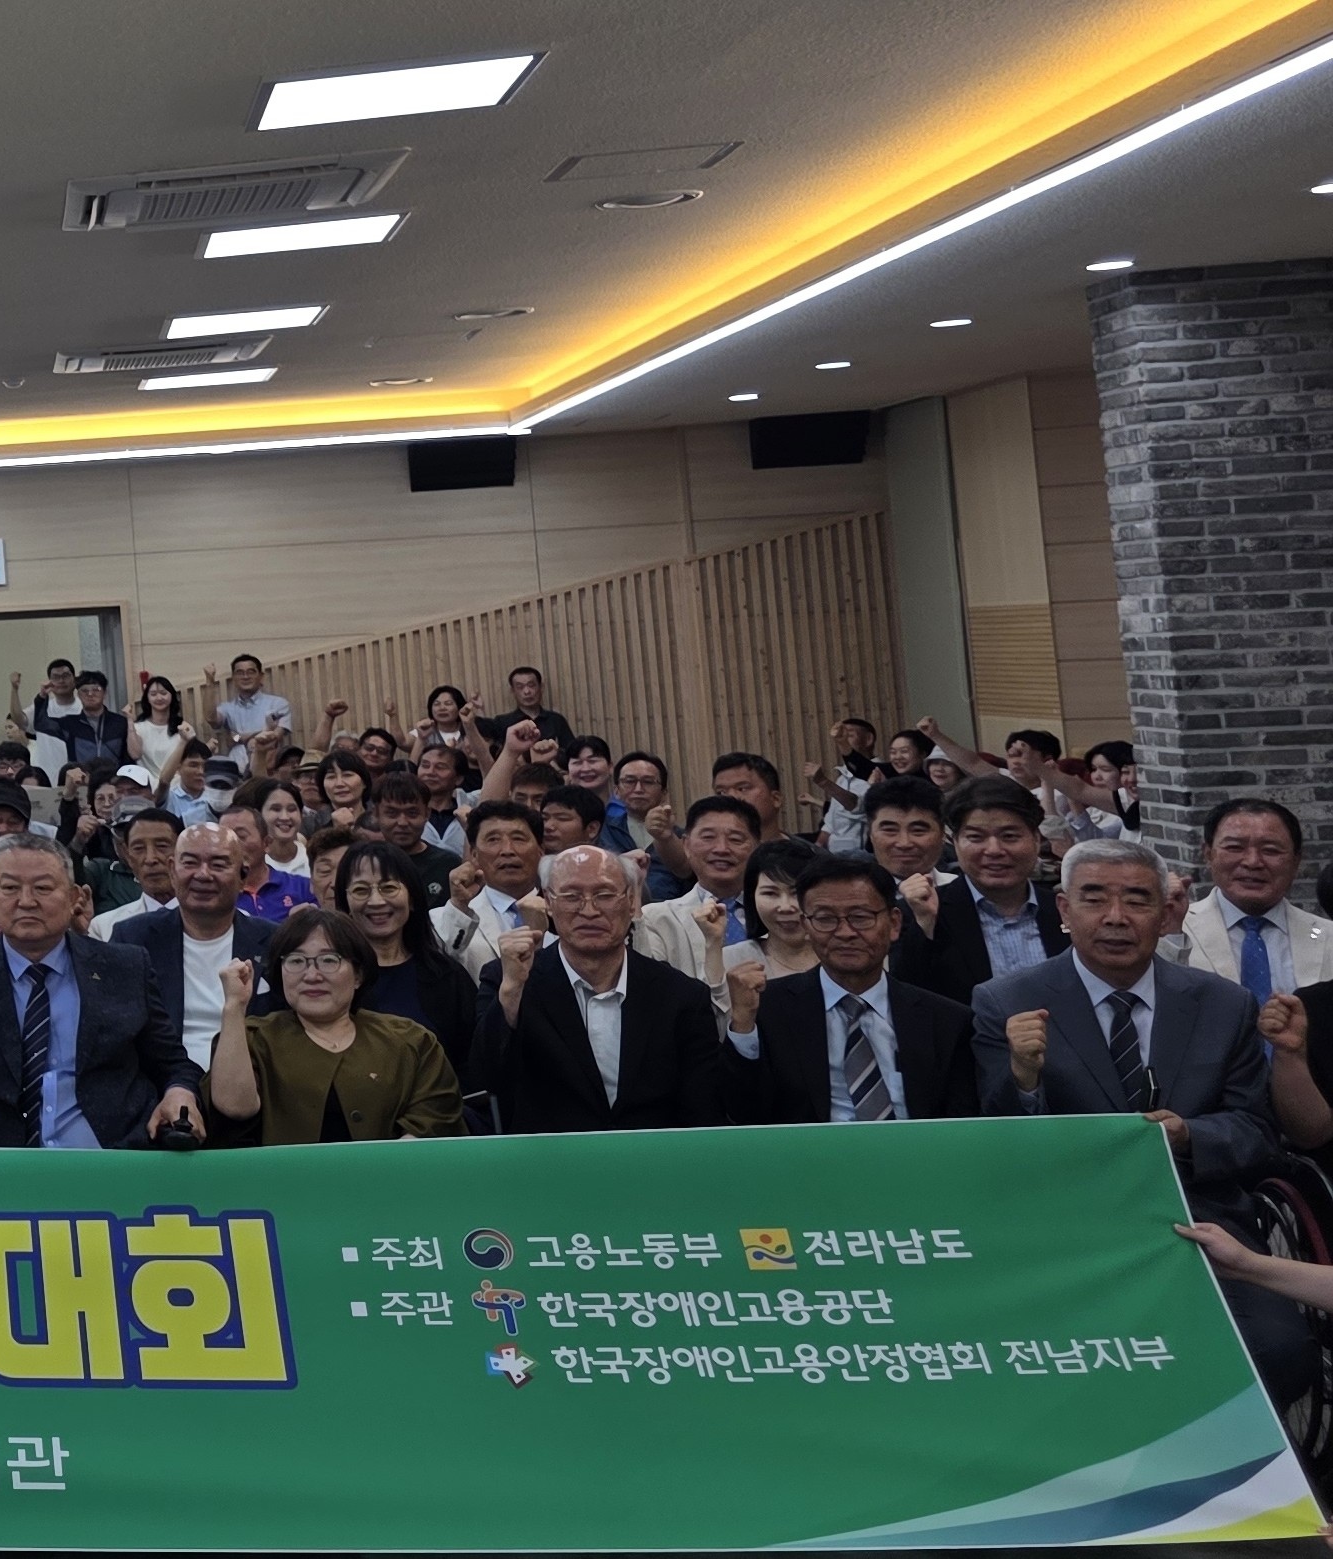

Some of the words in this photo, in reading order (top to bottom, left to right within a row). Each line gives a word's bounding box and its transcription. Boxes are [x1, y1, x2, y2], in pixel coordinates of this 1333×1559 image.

[371, 1236, 444, 1271] 주최
[526, 1232, 722, 1270] 고용노동부
[802, 1228, 973, 1266] 전라남도
[380, 1291, 454, 1326] 주관
[536, 1288, 895, 1328] 한국장애인고용공단
[550, 1341, 993, 1385] 한국장애인고용안정협회
[1000, 1335, 1175, 1375] 전남지부
